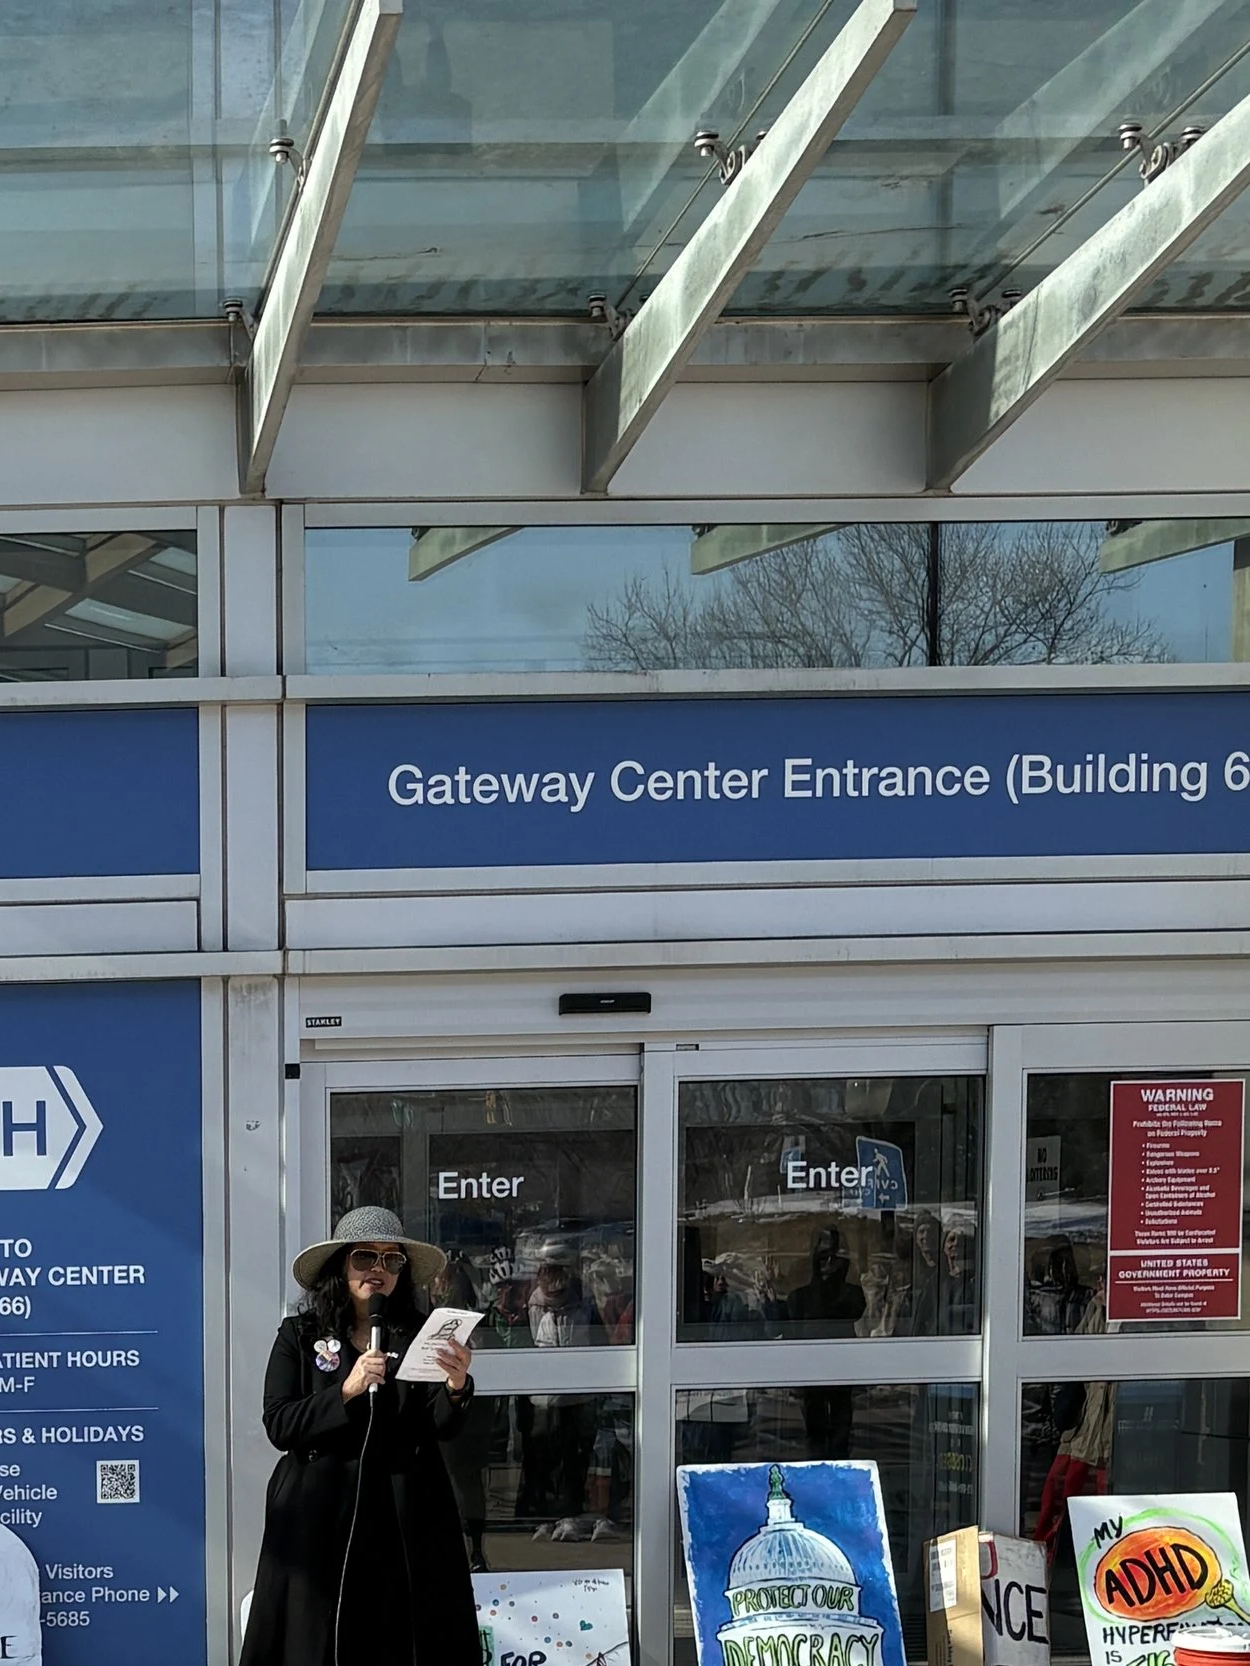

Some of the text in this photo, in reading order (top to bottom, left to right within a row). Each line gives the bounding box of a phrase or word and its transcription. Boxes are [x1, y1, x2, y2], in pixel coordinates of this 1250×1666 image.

[388, 764, 595, 813] Gateway
[610, 760, 768, 801] Center
[784, 758, 990, 798] Entrance
[1007, 752, 1208, 804] (Building
[1140, 1088, 1214, 1102] WARNING
[1148, 1103, 1207, 1112] FEDERAL LAW
[787, 1160, 874, 1188] Enter
[438, 1171, 524, 1199] Enter
[0, 1239, 32, 1258] TO
[1140, 1258, 1209, 1268] UNITED STATES
[48, 1265, 145, 1286] CENTER
[1119, 1268, 1231, 1279] GOVERNMENT PROPERTY
[67, 1350, 140, 1367] HOURS
[22, 1427, 36, 1445] &
[41, 1425, 145, 1444] HOLIDAYS
[1094, 1515, 1123, 1548] MY
[45, 1563, 114, 1580] Visitors
[1104, 1543, 1209, 1608] ADHD
[39, 1586, 150, 1604] ance Phone
[731, 1584, 855, 1616] PROTECT OUR
[1105, 1650, 1122, 1665] IS
